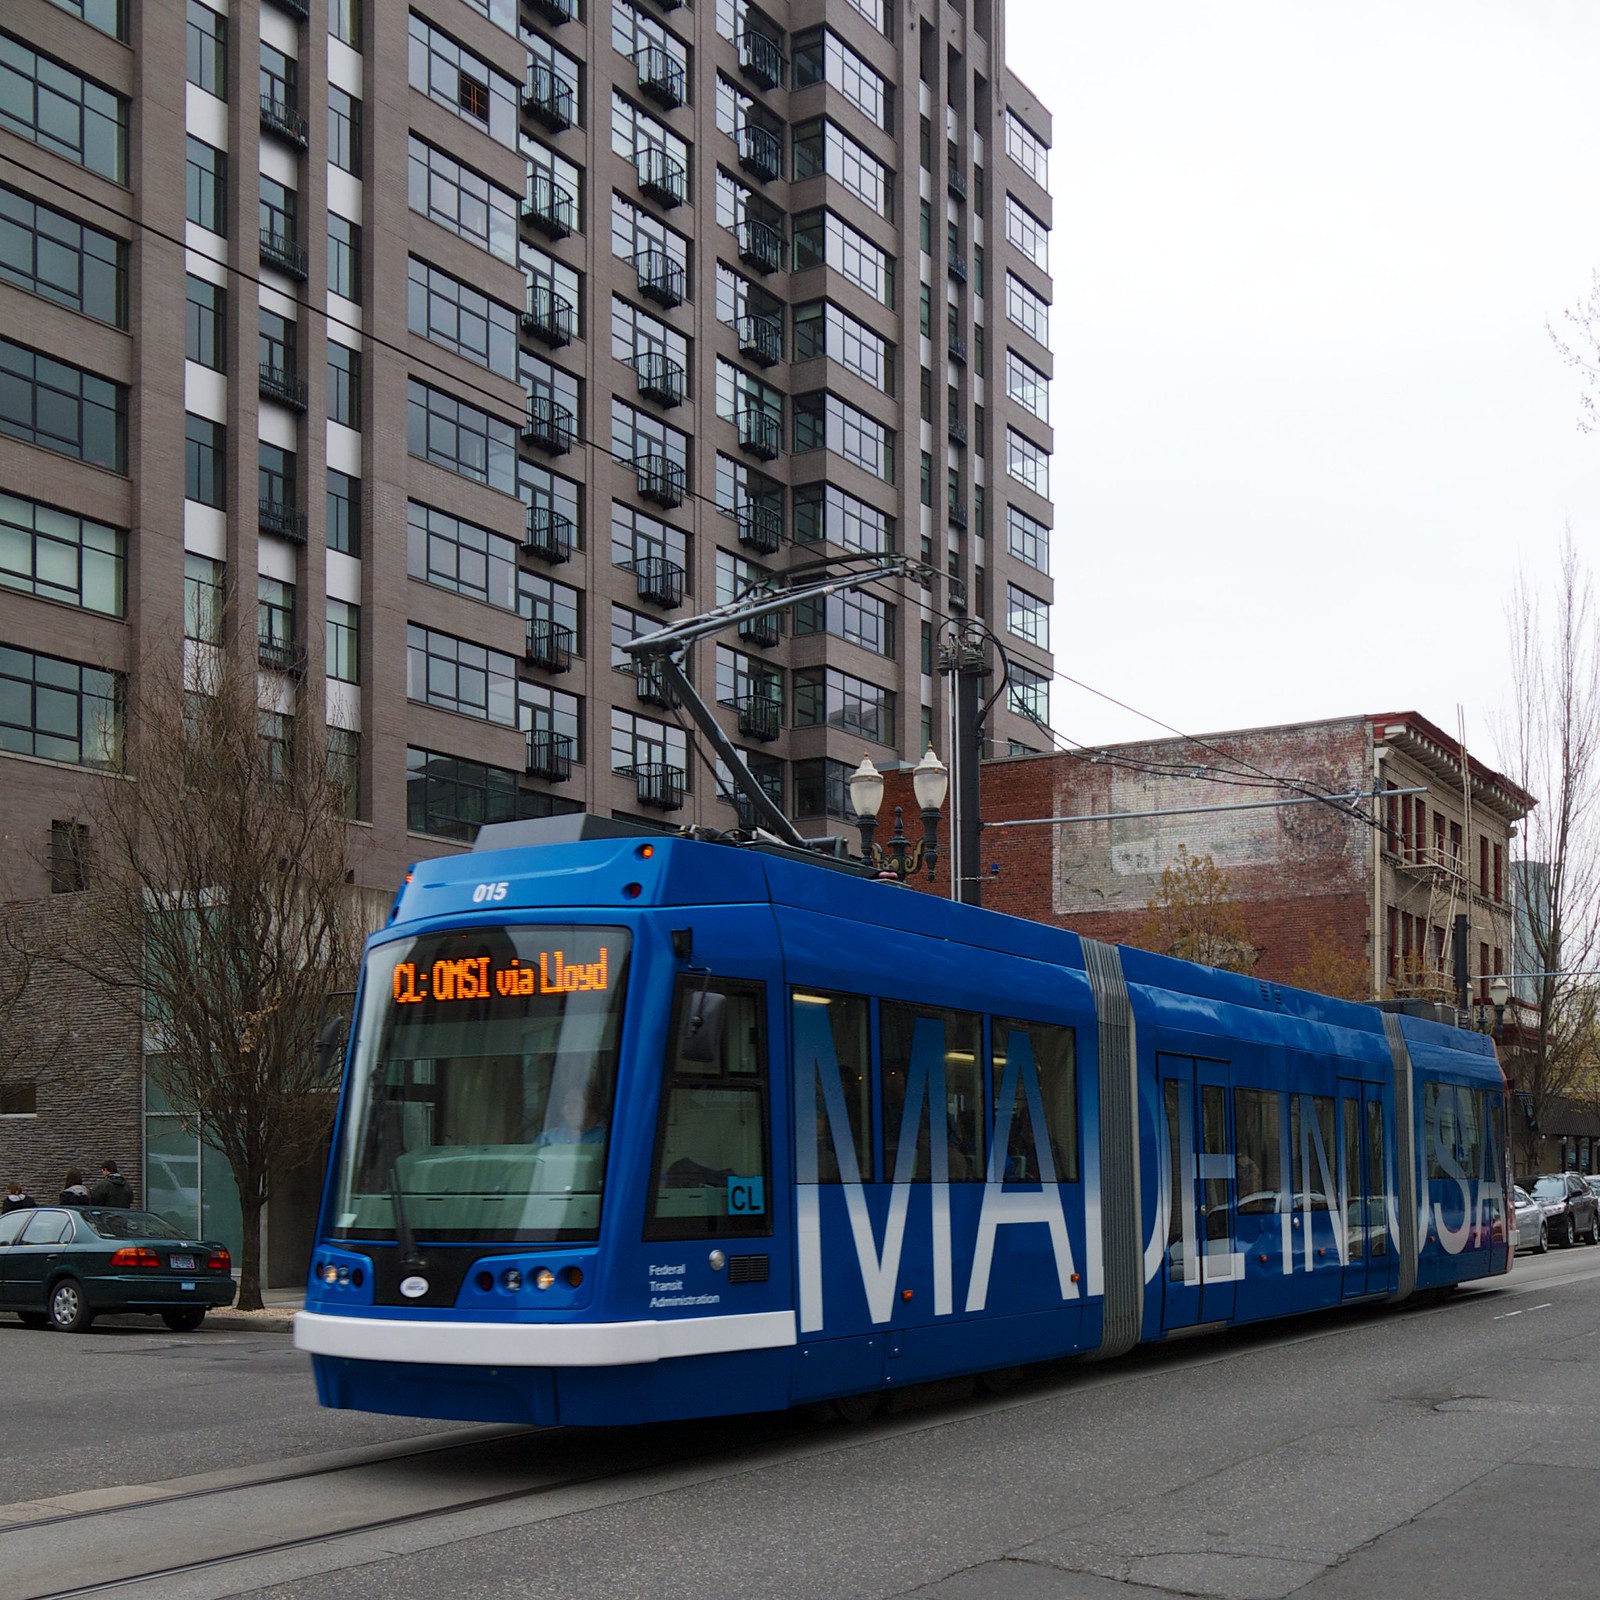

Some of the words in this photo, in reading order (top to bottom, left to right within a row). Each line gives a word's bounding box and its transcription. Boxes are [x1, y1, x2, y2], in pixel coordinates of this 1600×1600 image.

[472, 881, 509, 903] 015
[393, 963, 428, 1003] CL:
[432, 957, 491, 1000] OMSI
[496, 959, 535, 996] via
[540, 948, 608, 994] Lloyd
[793, 1002, 1246, 1333] MADE
[1278, 1091, 1350, 1275] IN
[1385, 1083, 1508, 1255] USA
[731, 1185, 761, 1211] CL
[649, 1264, 686, 1276] Federal
[649, 1280, 684, 1292] Transit
[649, 1294, 720, 1308] Administration
